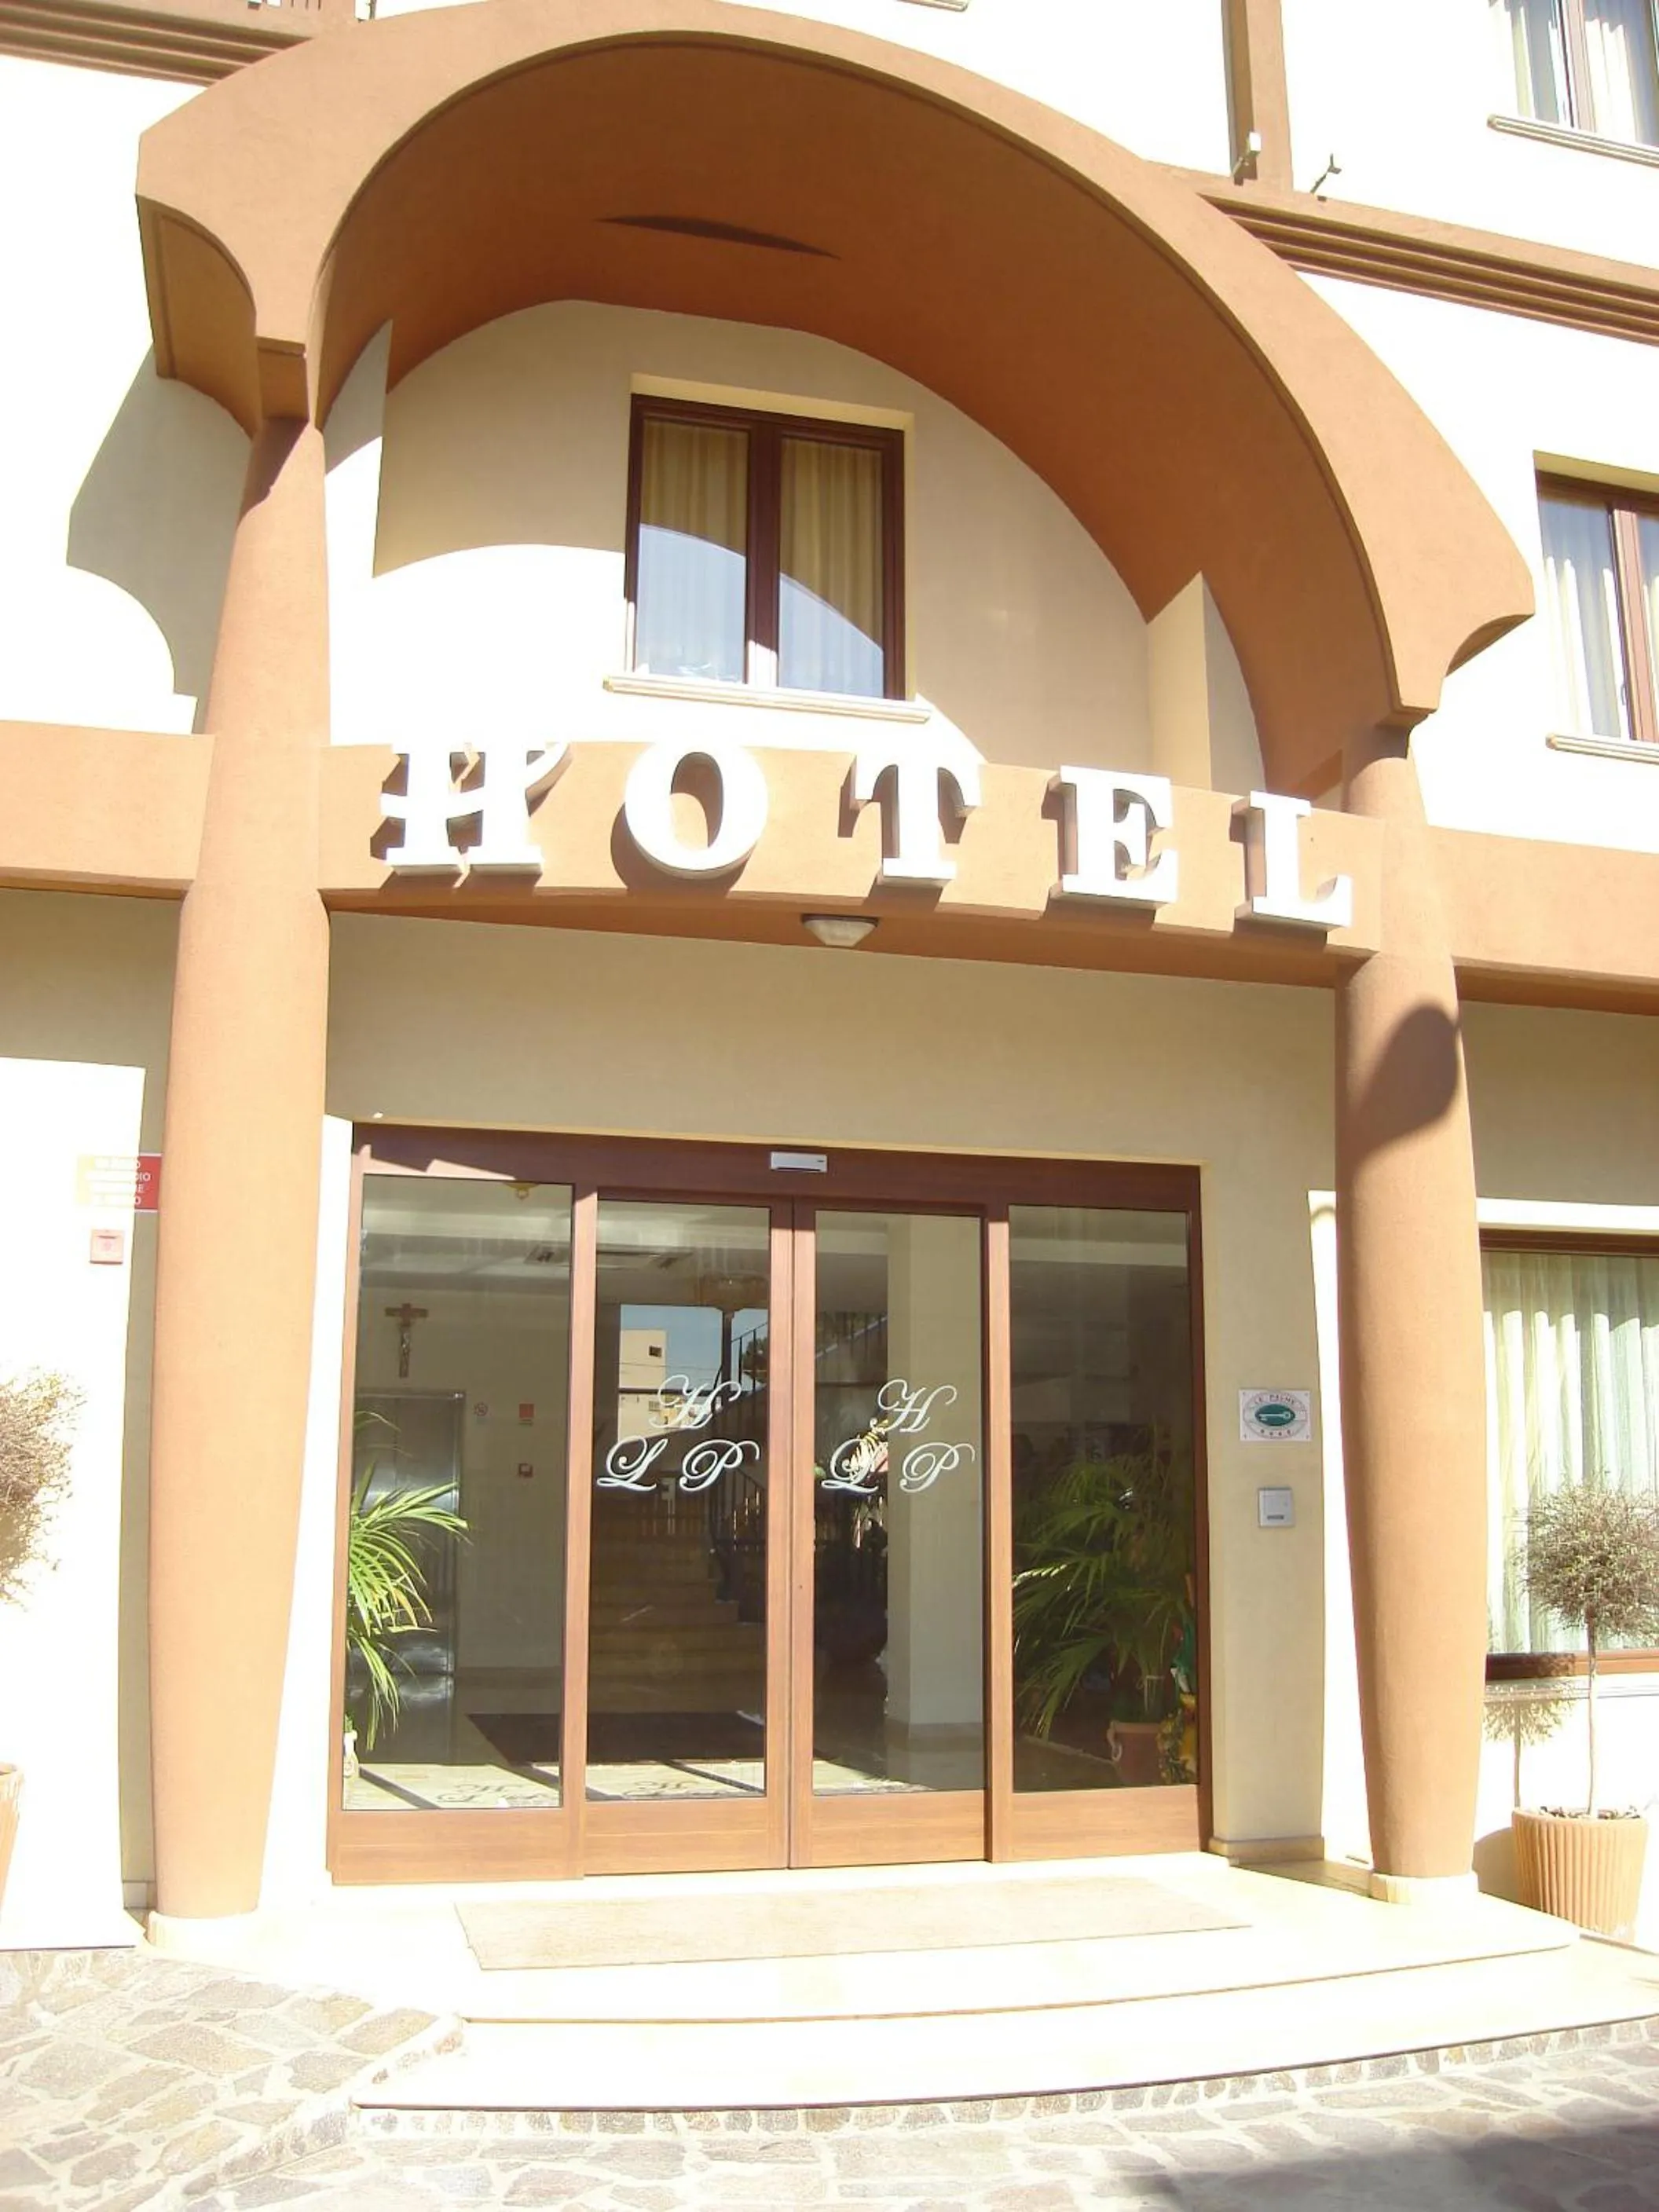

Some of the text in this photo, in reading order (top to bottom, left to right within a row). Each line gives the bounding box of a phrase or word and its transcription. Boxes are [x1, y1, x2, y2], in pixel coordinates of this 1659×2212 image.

[380, 737, 1353, 928] HOTEL
[649, 1374, 742, 1430] H
[870, 1379, 958, 1433] H
[679, 1438, 760, 1492] P
[899, 1441, 976, 1493] P
